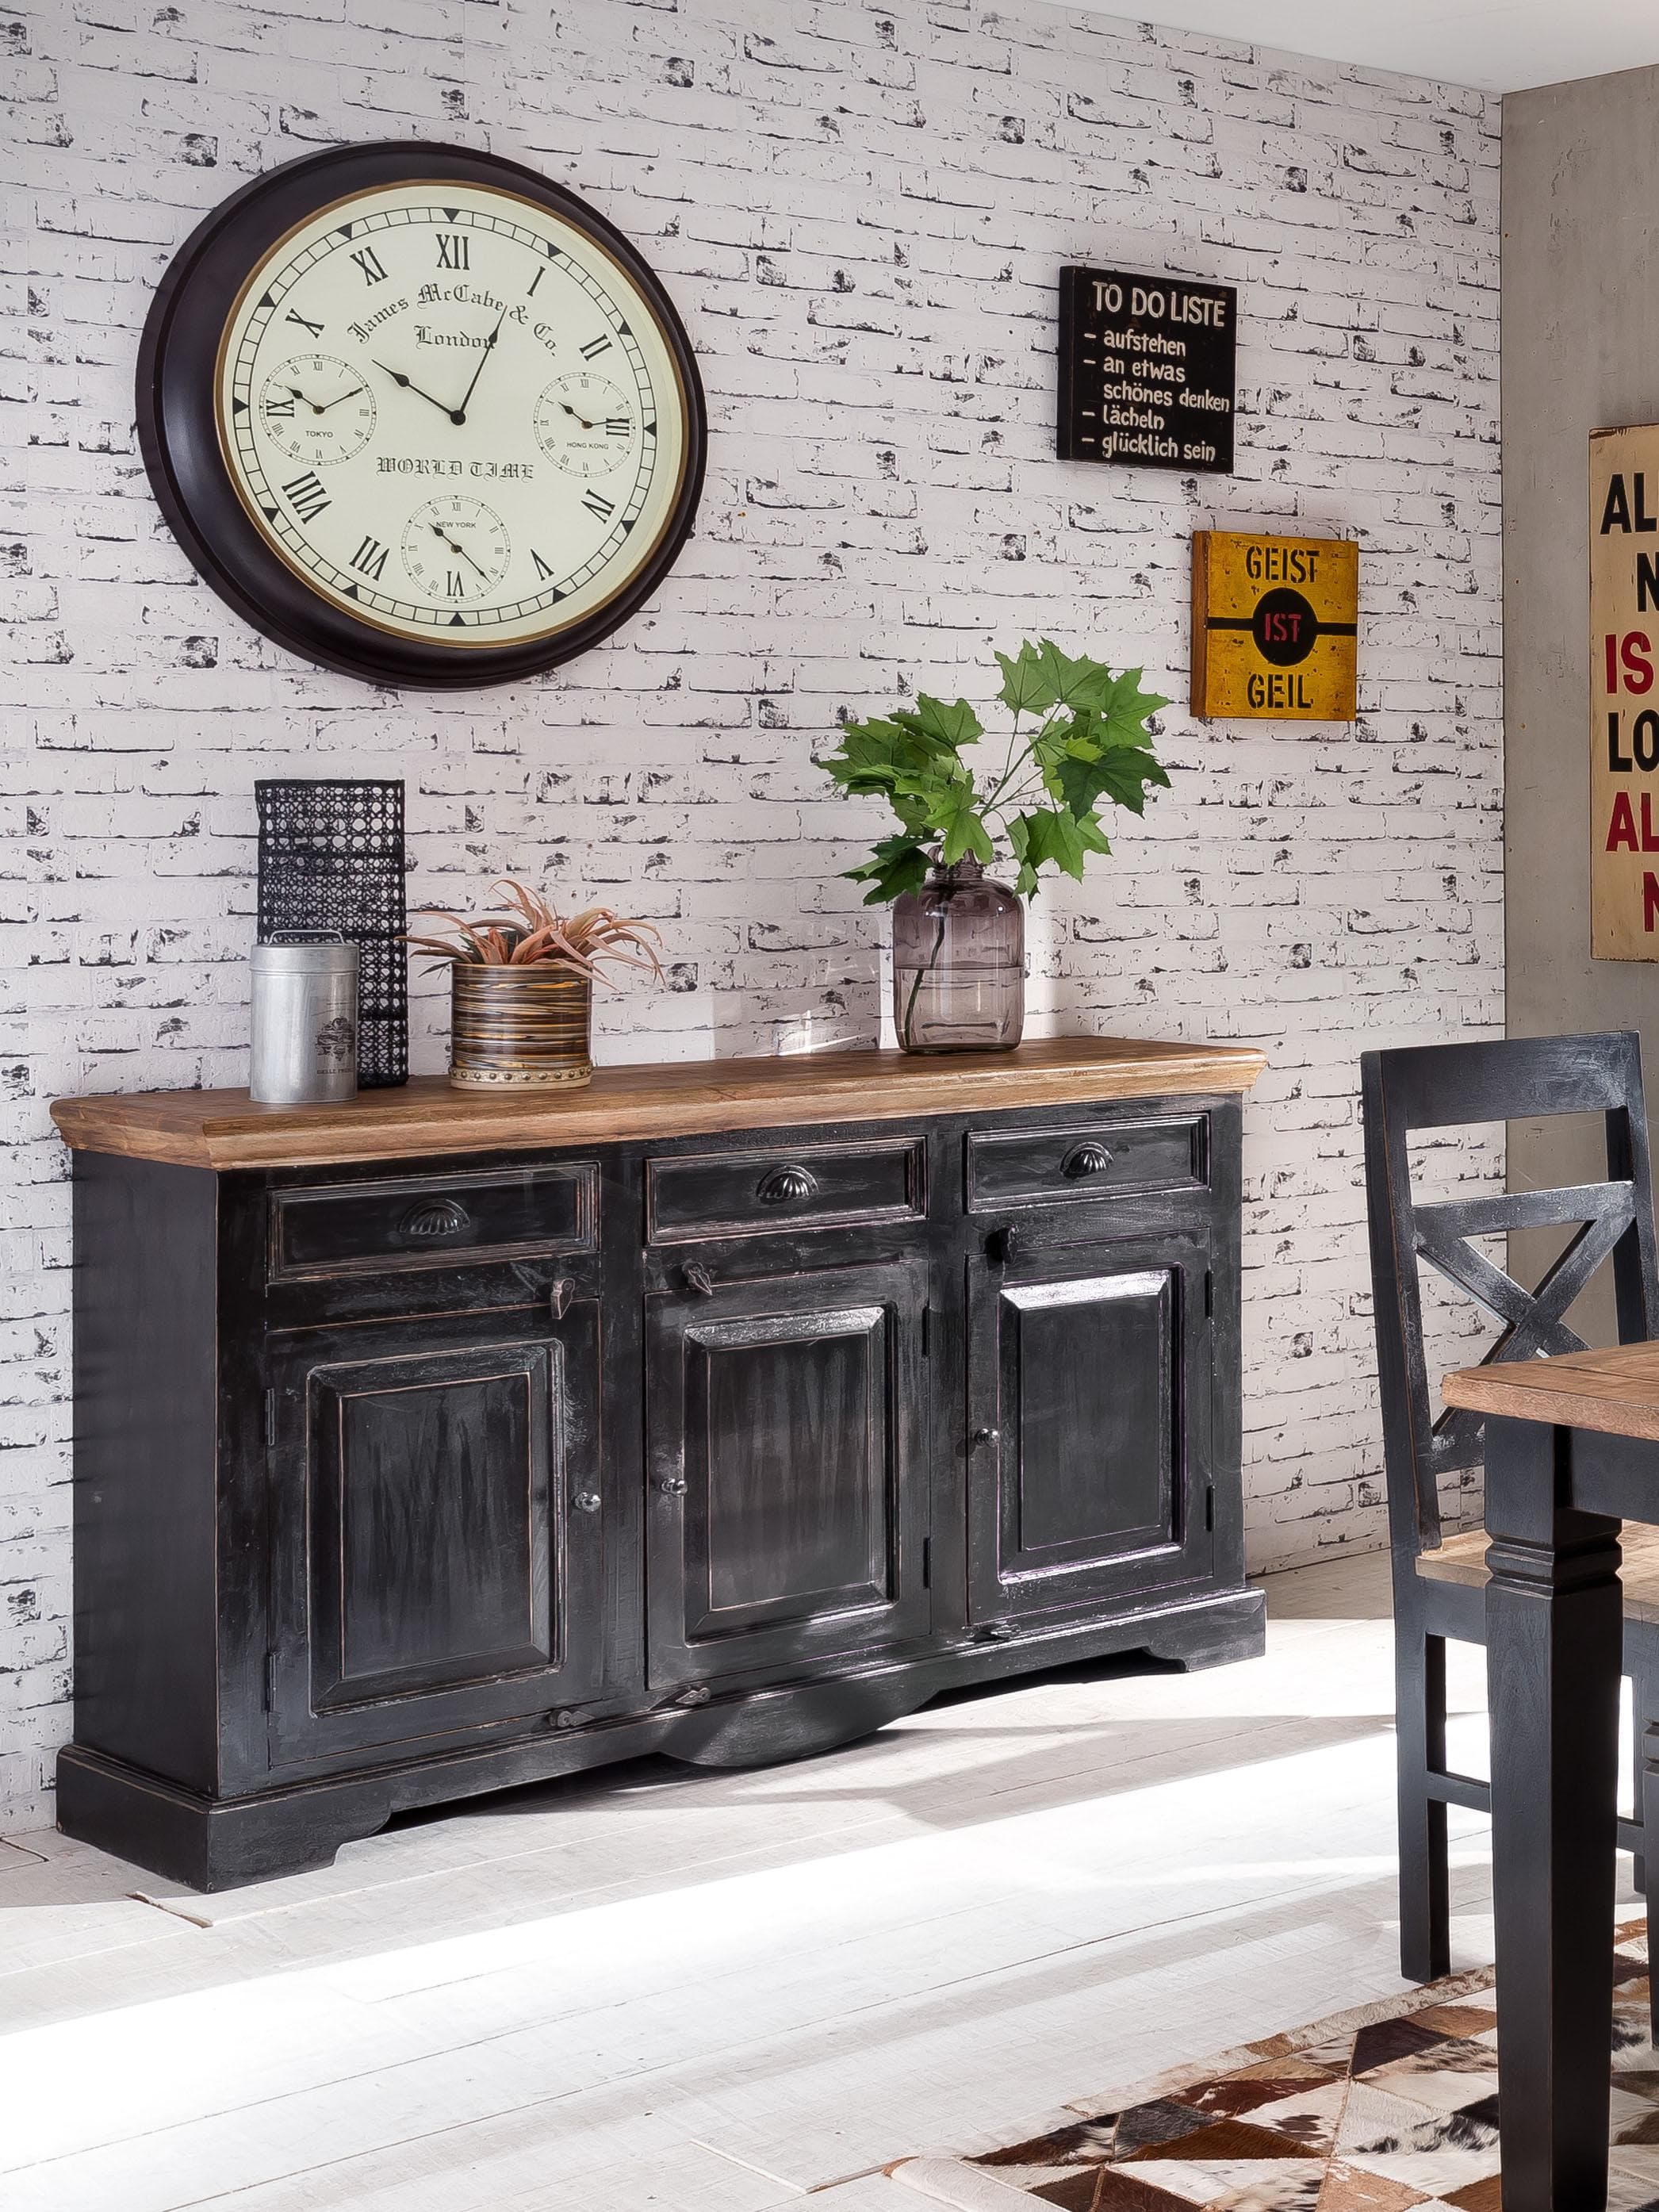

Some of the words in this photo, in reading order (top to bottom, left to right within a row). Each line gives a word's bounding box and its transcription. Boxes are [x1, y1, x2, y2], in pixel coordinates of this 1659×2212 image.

[350, 246, 389, 286] XI
[435, 233, 469, 270] XII
[527, 266, 546, 297] I
[347, 297, 409, 344] James
[416, 282, 505, 312] McCabe
[508, 305, 530, 325] &
[533, 321, 558, 357] Co.
[1092, 281, 1123, 312] TO
[1132, 287, 1165, 318] DO
[1170, 291, 1226, 327] LISTE
[285, 308, 324, 339] X
[413, 324, 496, 350] London
[579, 333, 613, 362] II
[1103, 328, 1186, 357] aufstehen
[1103, 356, 1125, 374] an
[1132, 359, 1186, 382] etwas
[266, 399, 294, 418] IX
[1103, 380, 1173, 407] schönes
[1178, 387, 1230, 412] denken
[1103, 404, 1165, 430] lächeln
[1102, 431, 1178, 458] glücklich
[1183, 440, 1216, 462] sein
[376, 456, 463, 481] WORLD
[470, 462, 534, 483] TIME
[282, 470, 332, 524] VIII
[581, 489, 615, 523] IV
[349, 535, 390, 581] VII
[530, 548, 554, 581] V
[1246, 545, 1320, 584] GEIST
[446, 570, 465, 596] VI
[1264, 613, 1301, 642] IST
[1604, 631, 1654, 696] IS
[1247, 674, 1312, 709] GEIL
